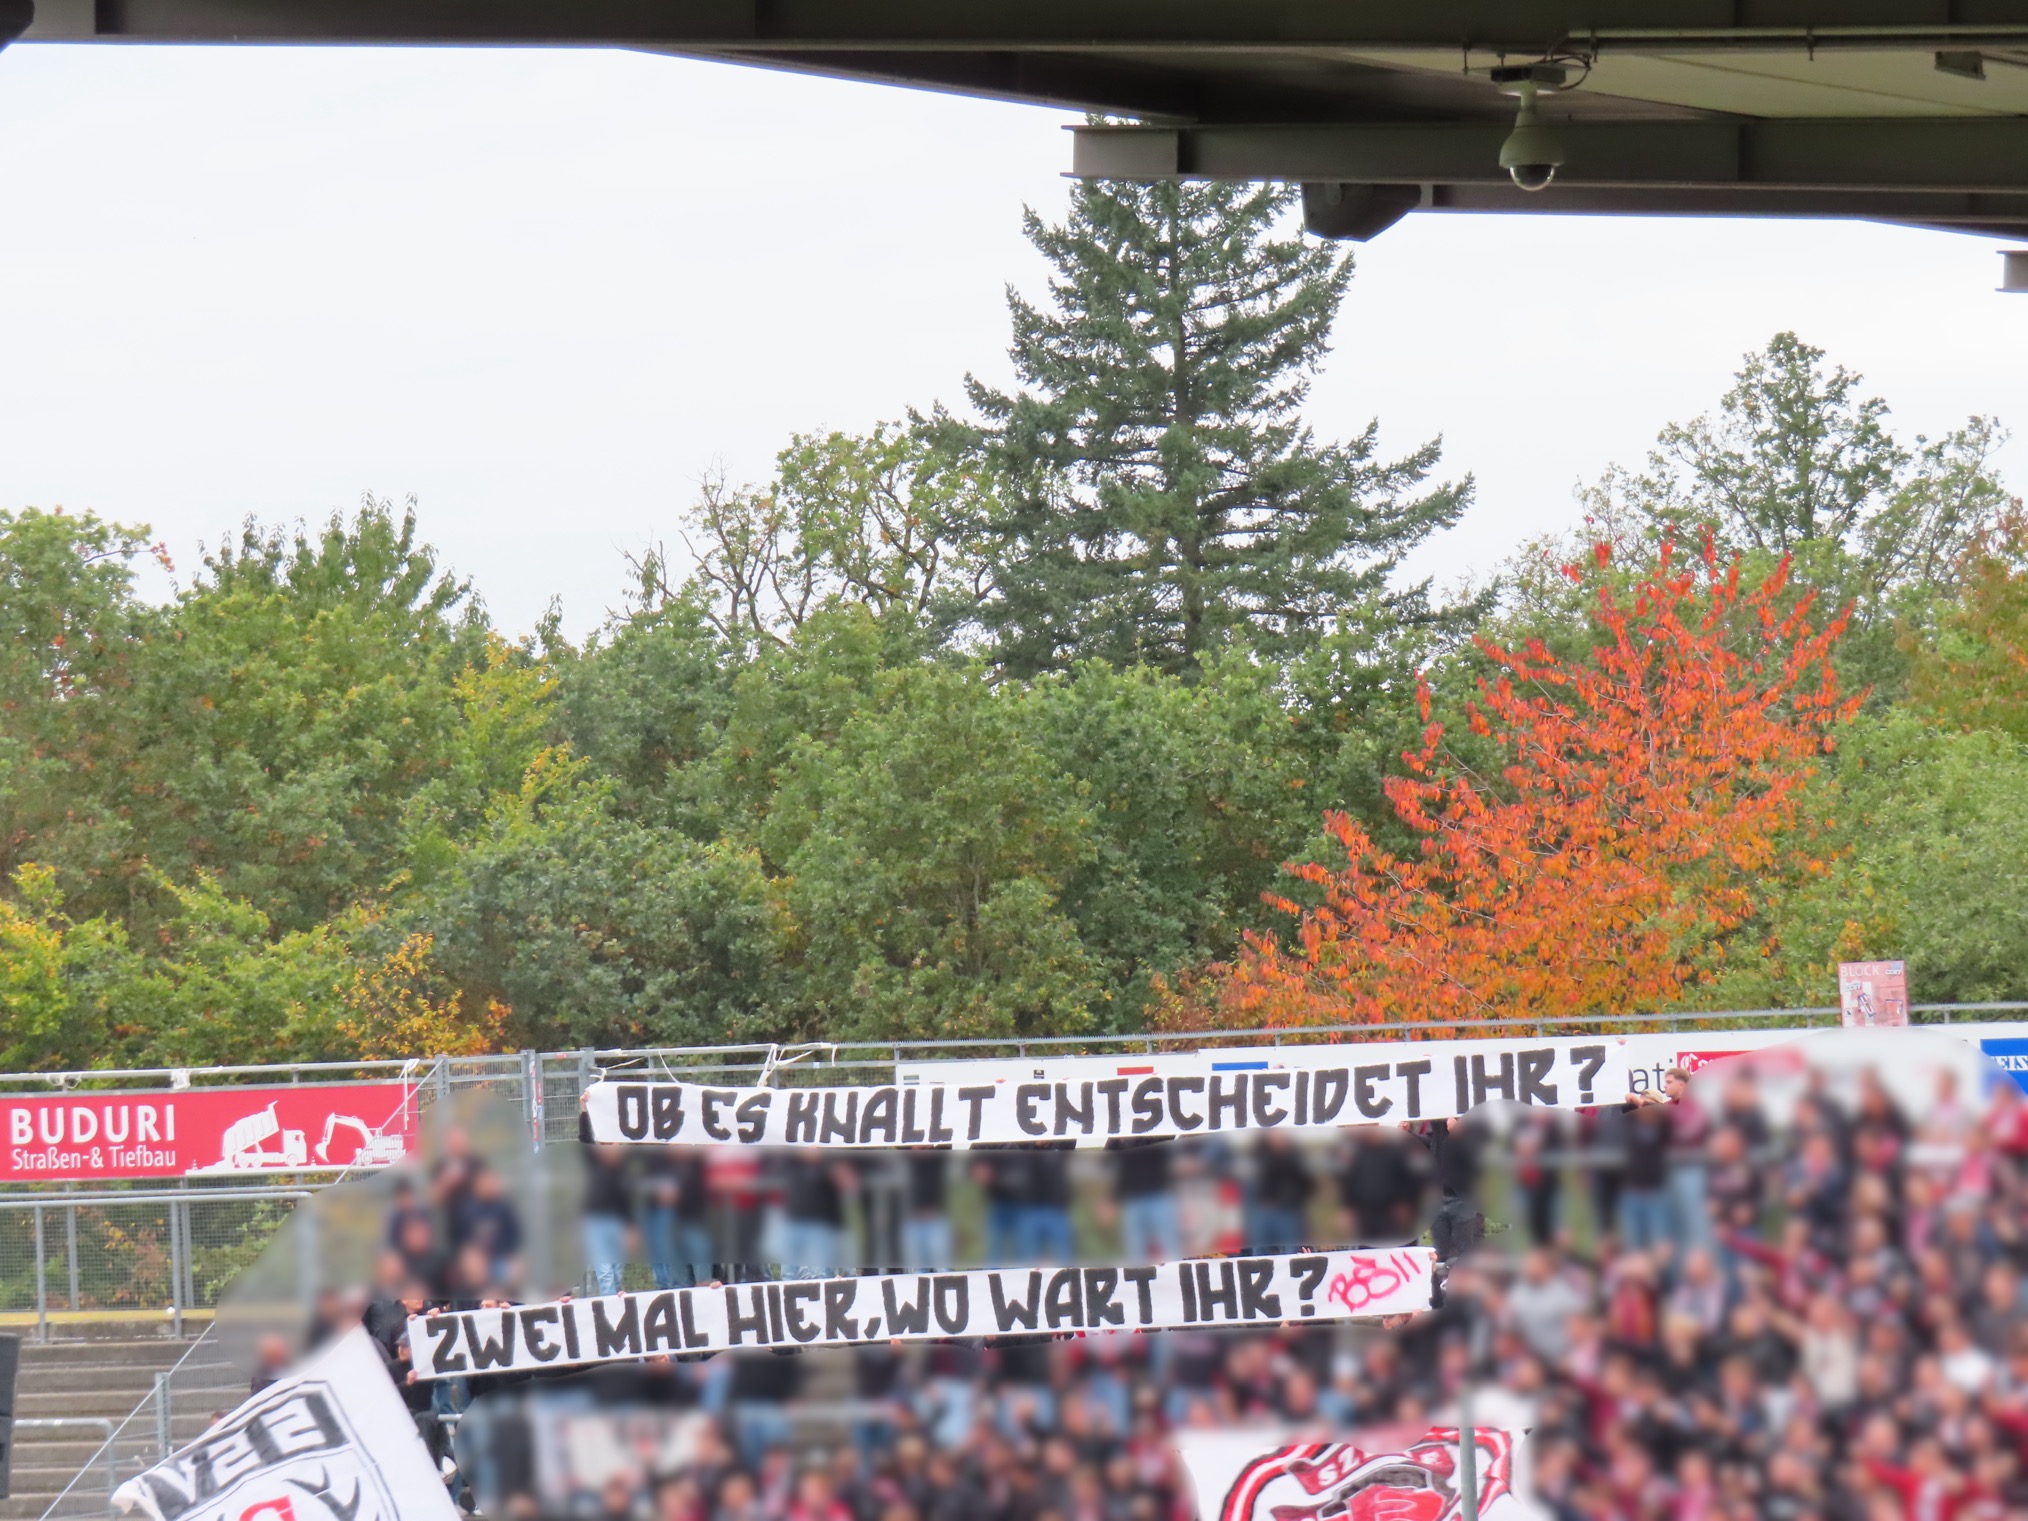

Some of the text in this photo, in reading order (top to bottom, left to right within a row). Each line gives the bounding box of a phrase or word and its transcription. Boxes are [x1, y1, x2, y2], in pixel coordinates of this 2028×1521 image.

[1840, 965, 1880, 978] BLOCK
[617, 1086, 684, 1141] OB
[702, 1089, 772, 1143] ES
[786, 1086, 995, 1143] KNALLT
[1016, 1060, 1430, 1136] ENTSCHEIDET
[12, 1104, 175, 1145] BUDURI
[109, 1145, 176, 1168] Tiefbau
[426, 1305, 581, 1374] ZWEI
[592, 1290, 709, 1357] MAL
[988, 1265, 1157, 1331] WART
